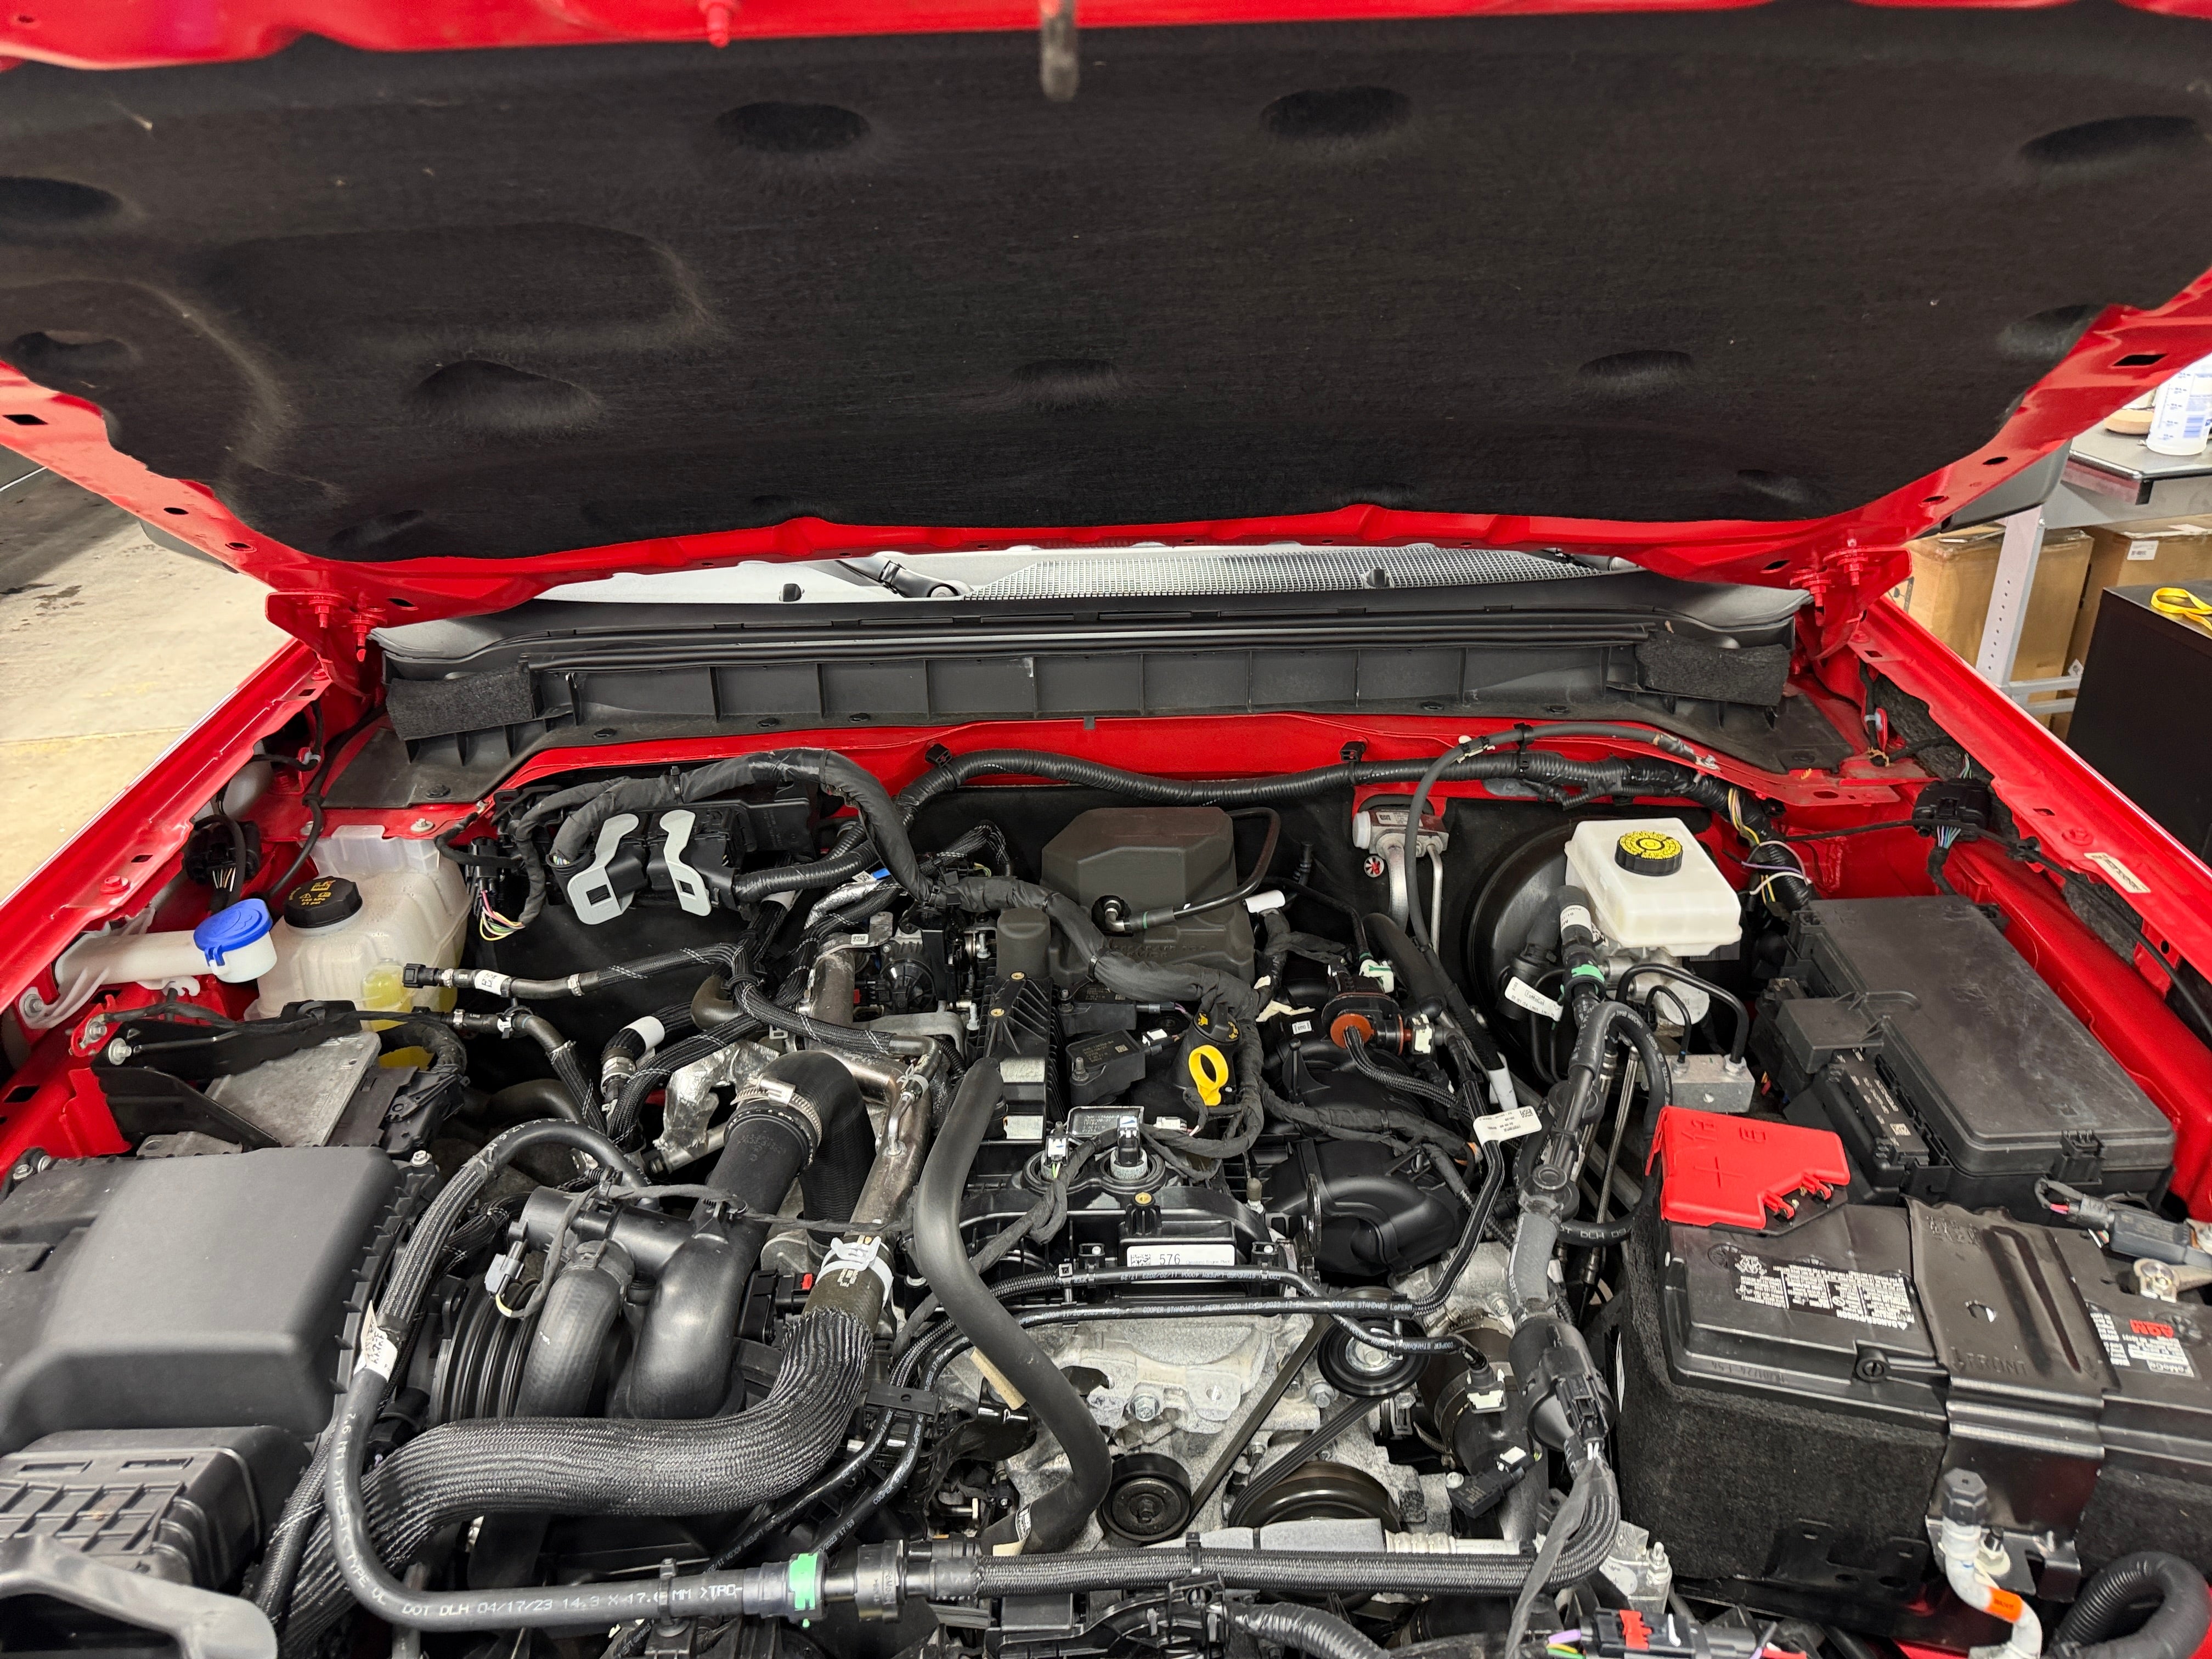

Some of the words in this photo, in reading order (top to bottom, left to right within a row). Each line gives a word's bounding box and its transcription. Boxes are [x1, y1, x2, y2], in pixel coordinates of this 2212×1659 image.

[1159, 1254, 1181, 1265] 576
[1331, 1300, 1355, 1308] COOPER
[1358, 1301, 1387, 1310] STANDARD
[1836, 1310, 1898, 1328] DANGER/POISON
[1966, 1352, 2027, 1375] FRONT
[871, 1484, 896, 1505] COOPER
[346, 1553, 370, 1588] TYPE
[402, 1603, 432, 1616] DOT
[439, 1604, 469, 1616] DLH
[478, 1599, 552, 1614] 04/17/23
[562, 1595, 600, 1610] 14.3
[608, 1595, 619, 1606] X
[672, 1589, 691, 1601] MM
